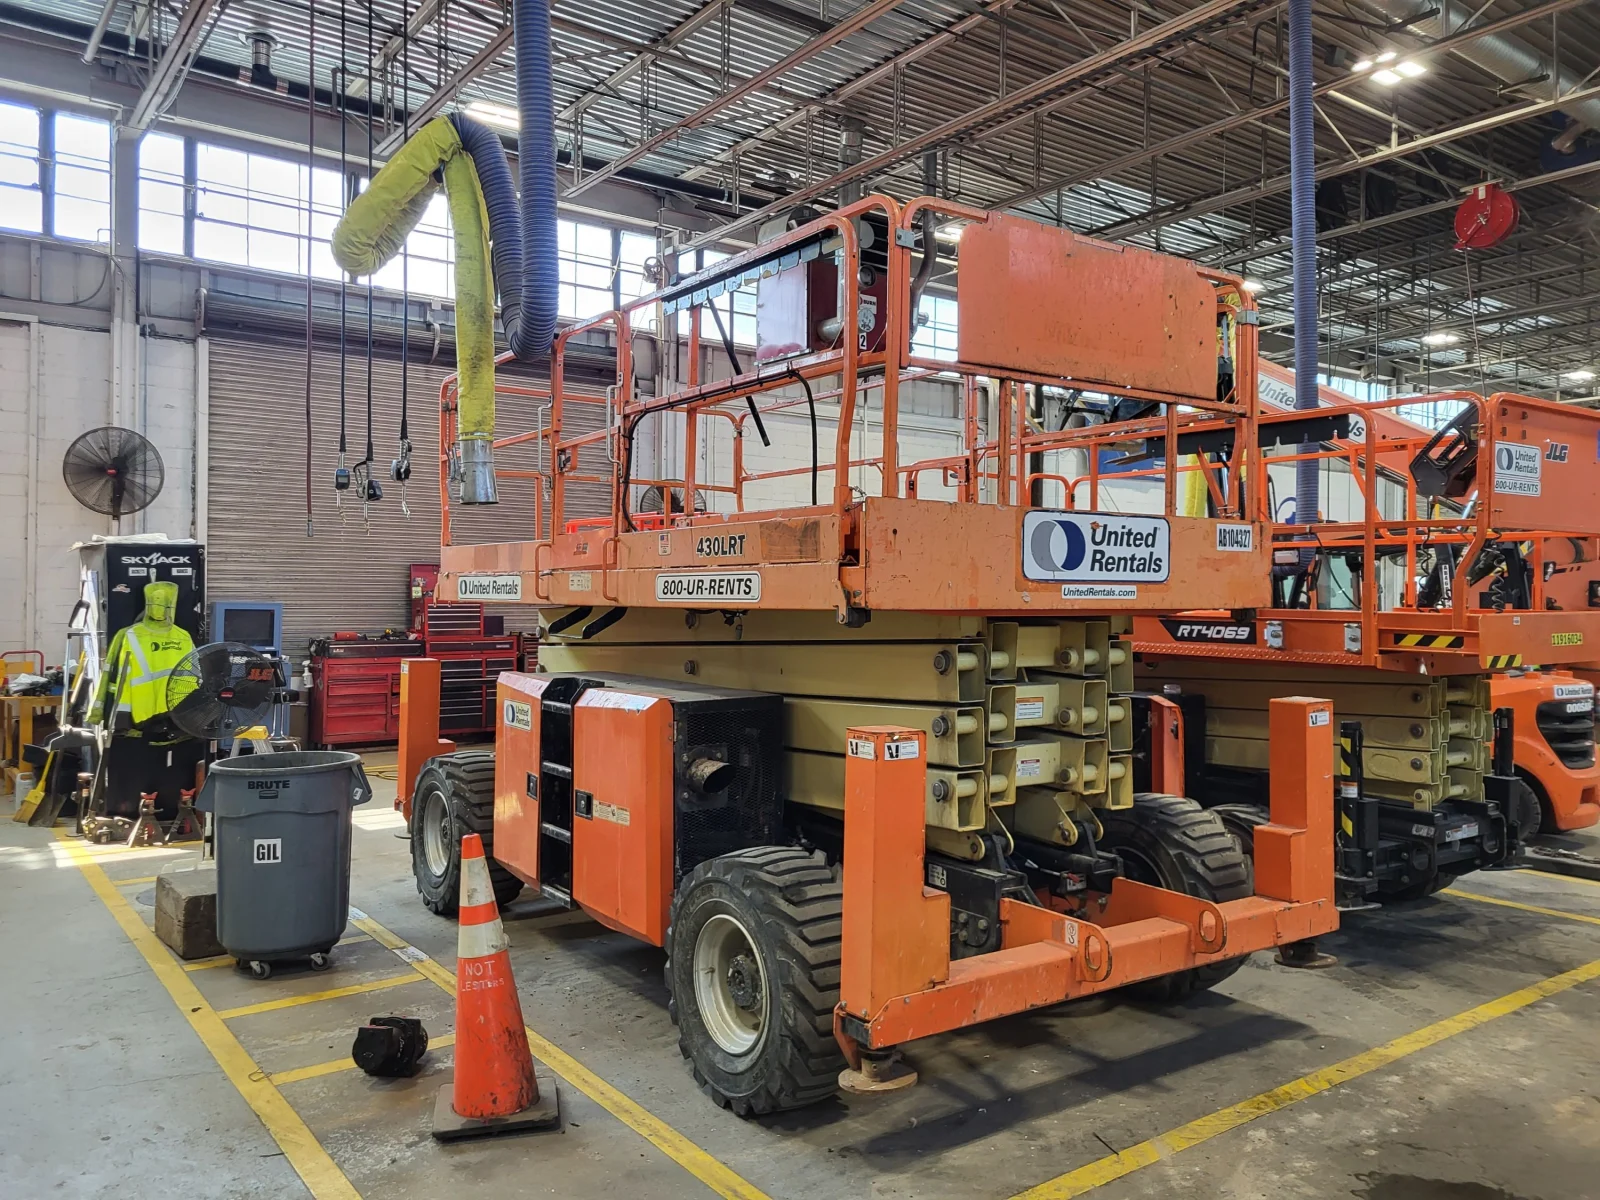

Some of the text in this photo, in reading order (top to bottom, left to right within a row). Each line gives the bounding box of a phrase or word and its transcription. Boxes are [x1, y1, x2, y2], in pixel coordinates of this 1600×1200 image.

[860, 334, 866, 348] 2
[1515, 449, 1538, 463] United
[1545, 443, 1569, 462] JLG
[1514, 461, 1538, 474] Rentals
[1495, 480, 1539, 493] 800-UR-RENTS
[1090, 523, 1159, 549] United
[1218, 528, 1251, 548] AB104327
[696, 534, 746, 556] 430LRT
[121, 552, 192, 566] SKYJACK
[1089, 549, 1163, 573] Rentals
[468, 578, 519, 595] United Rentals
[662, 577, 753, 596] 800-UR-RENTS
[1062, 587, 1136, 597] UnitedRentals.com
[1177, 624, 1251, 640] RT4069
[1551, 632, 1583, 645] 11916034
[515, 704, 530, 717] United
[515, 715, 530, 728] Rentals
[247, 780, 290, 790] BRUTE
[256, 843, 279, 861] GIL
[465, 960, 496, 976] NOT
